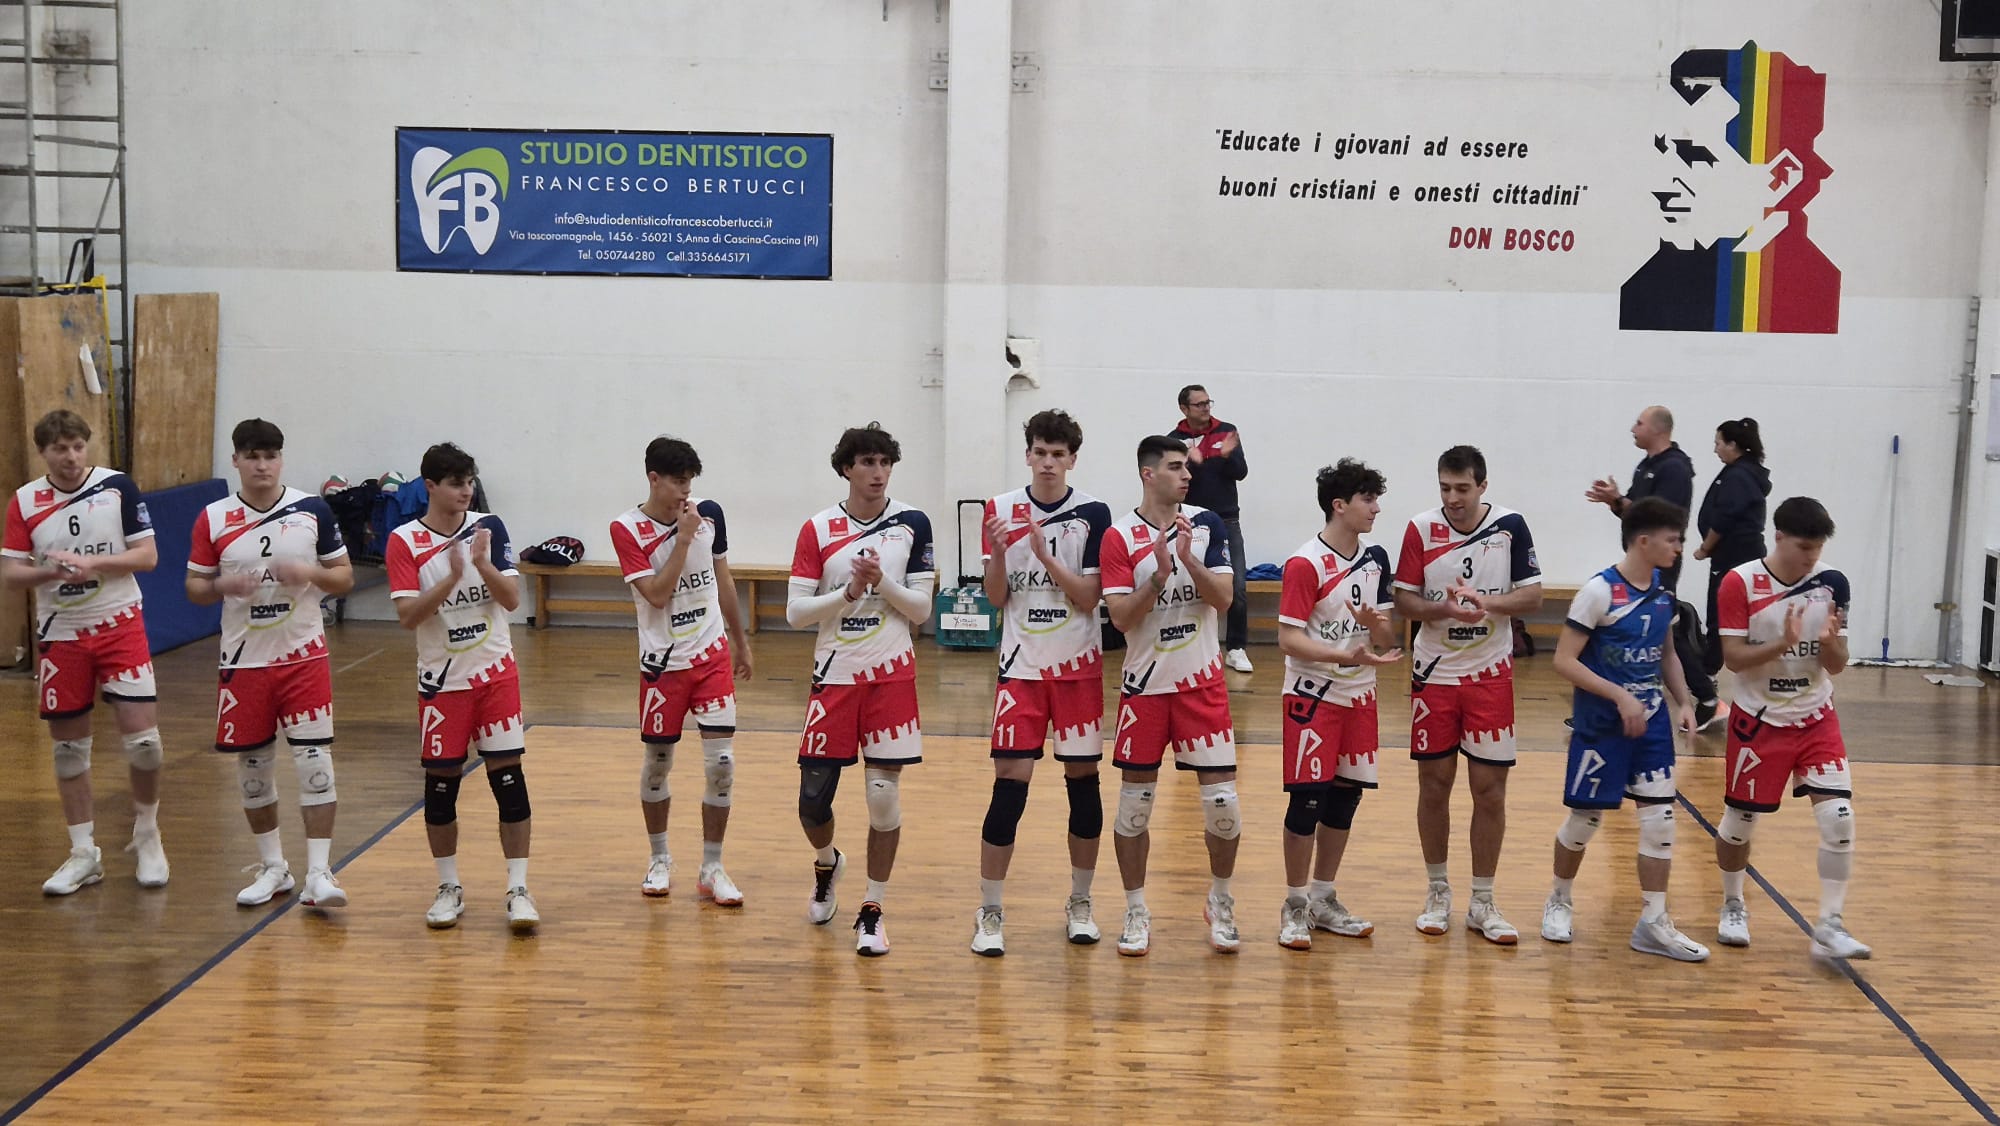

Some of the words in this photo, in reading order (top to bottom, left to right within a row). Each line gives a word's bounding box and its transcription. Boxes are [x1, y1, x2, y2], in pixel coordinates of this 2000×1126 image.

[520, 141, 628, 167] STUDIO
[638, 144, 808, 169] DENTISTICO
[1314, 133, 1322, 153] i
[1335, 134, 1410, 160] giovani
[1423, 136, 1449, 156] ad
[1460, 140, 1529, 159] essere
[521, 176, 669, 193] FRANCESCO
[688, 179, 805, 195] BERTUCCI
[1219, 176, 1277, 198] buoni
[1289, 178, 1377, 201] cristiani
[1389, 185, 1400, 201] e
[1414, 182, 1479, 204] onesti
[554, 213, 773, 228] info@studiodentisticofrancescobertucci.it
[509, 230, 526, 240] Via
[608, 232, 633, 242] 1456
[641, 232, 672, 242] 56021
[712, 233, 722, 244] di
[724, 234, 801, 245] Cascina-Cascina
[804, 235, 819, 247] (PI)
[1448, 226, 1492, 250] DON
[1504, 228, 1575, 252] BOSCO
[578, 250, 592, 260] Tel.
[595, 250, 656, 261] 050744280
[666, 251, 750, 263] Cell.3356645171
[68, 515, 80, 536] 6
[65, 542, 113, 556] ABEL
[260, 535, 272, 557] 2
[541, 543, 578, 562] VOLL
[1462, 557, 1474, 579] 3
[675, 569, 714, 593] ABE
[1157, 585, 1203, 606] KAB
[1351, 584, 1361, 606] 9
[250, 603, 290, 613] POWER
[1028, 609, 1067, 618] POWER
[448, 622, 488, 639] POWER
[841, 617, 880, 627] POWER
[1159, 623, 1197, 637] POWER
[1448, 627, 1488, 637] POWER
[1640, 614, 1651, 637] 7
[1783, 641, 1820, 657] ABE
[46, 688, 57, 710] 6
[224, 722, 235, 743] 2
[653, 713, 664, 734] 8
[431, 734, 443, 757] 5
[807, 731, 827, 755] 12
[997, 724, 1015, 747] 11
[1417, 729, 1429, 751] 3
[1121, 737, 1132, 760] 4
[1310, 757, 1322, 780] 9
[1588, 778, 1602, 799] 7
[1746, 779, 1756, 800] 1
